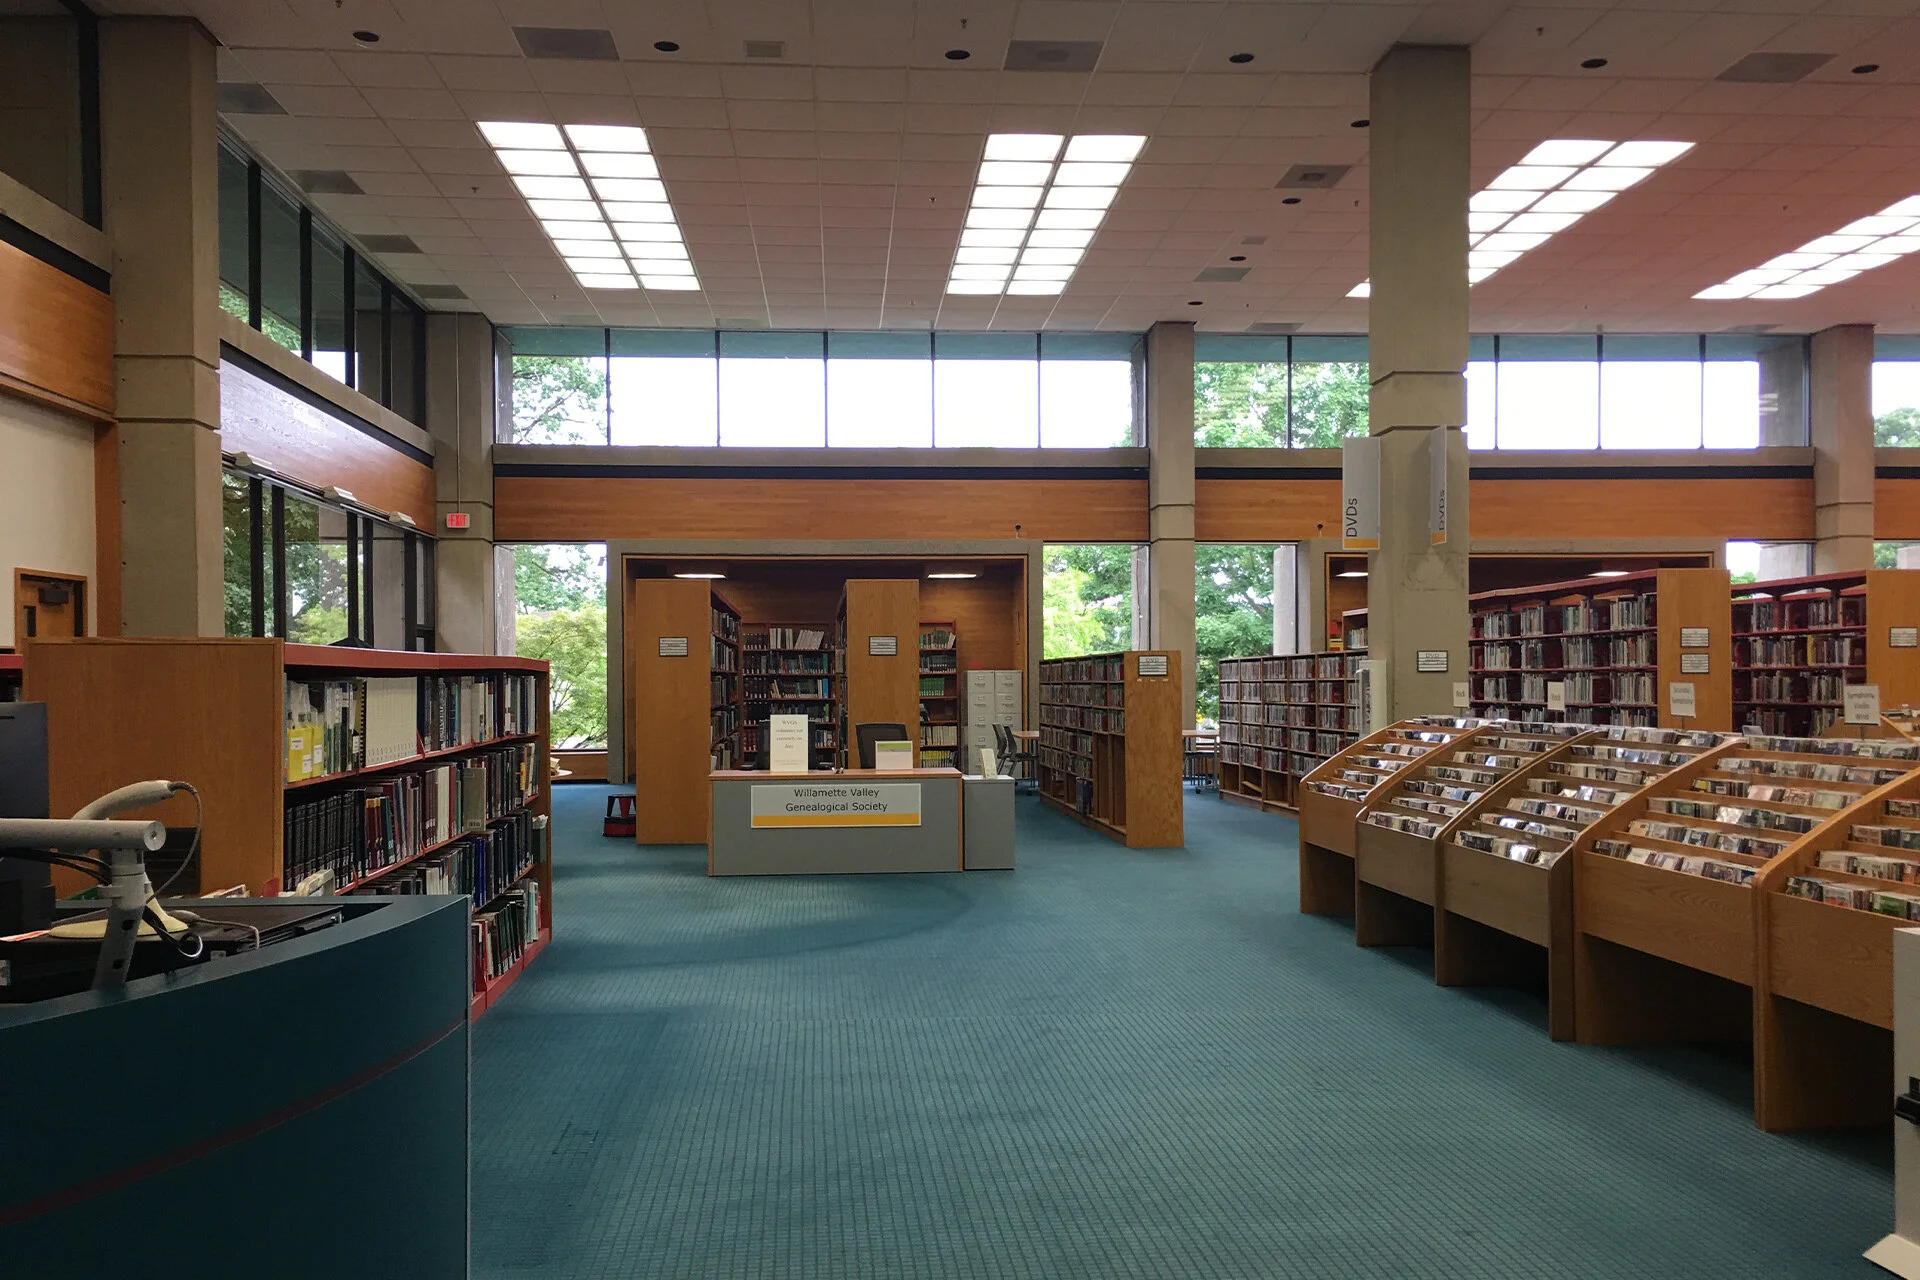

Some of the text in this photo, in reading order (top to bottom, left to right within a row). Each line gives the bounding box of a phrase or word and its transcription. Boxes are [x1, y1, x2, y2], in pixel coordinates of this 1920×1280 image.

[450, 514, 467, 527] EXIT
[1346, 498, 1358, 537] DVDs
[794, 788, 880, 798] Willamette Valley
[785, 802, 888, 813] Genealogical Society
